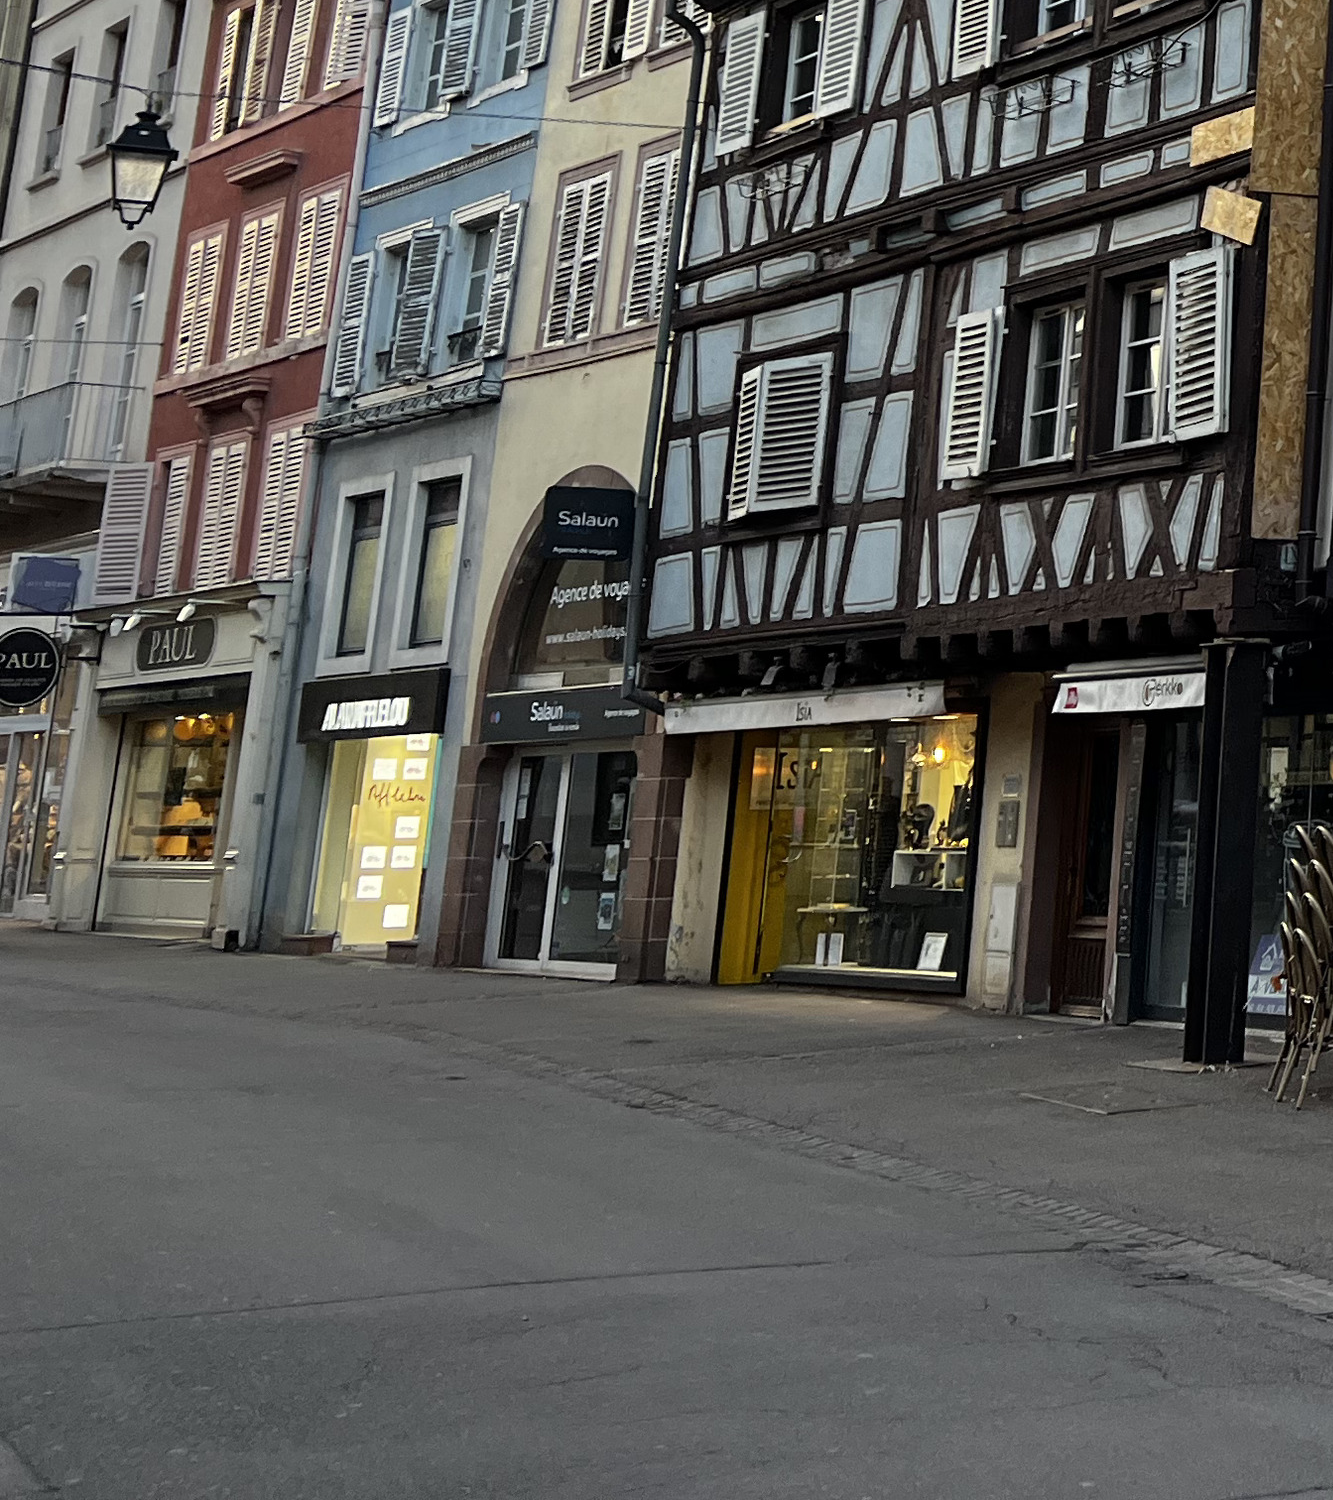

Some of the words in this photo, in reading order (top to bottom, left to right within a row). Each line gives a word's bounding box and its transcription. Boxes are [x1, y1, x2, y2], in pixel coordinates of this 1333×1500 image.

[550, 586, 588, 609] Agence
[589, 580, 603, 599] de
[604, 581, 630, 601] voya
[148, 624, 197, 665] PAUL
[0, 652, 54, 669] PAUL
